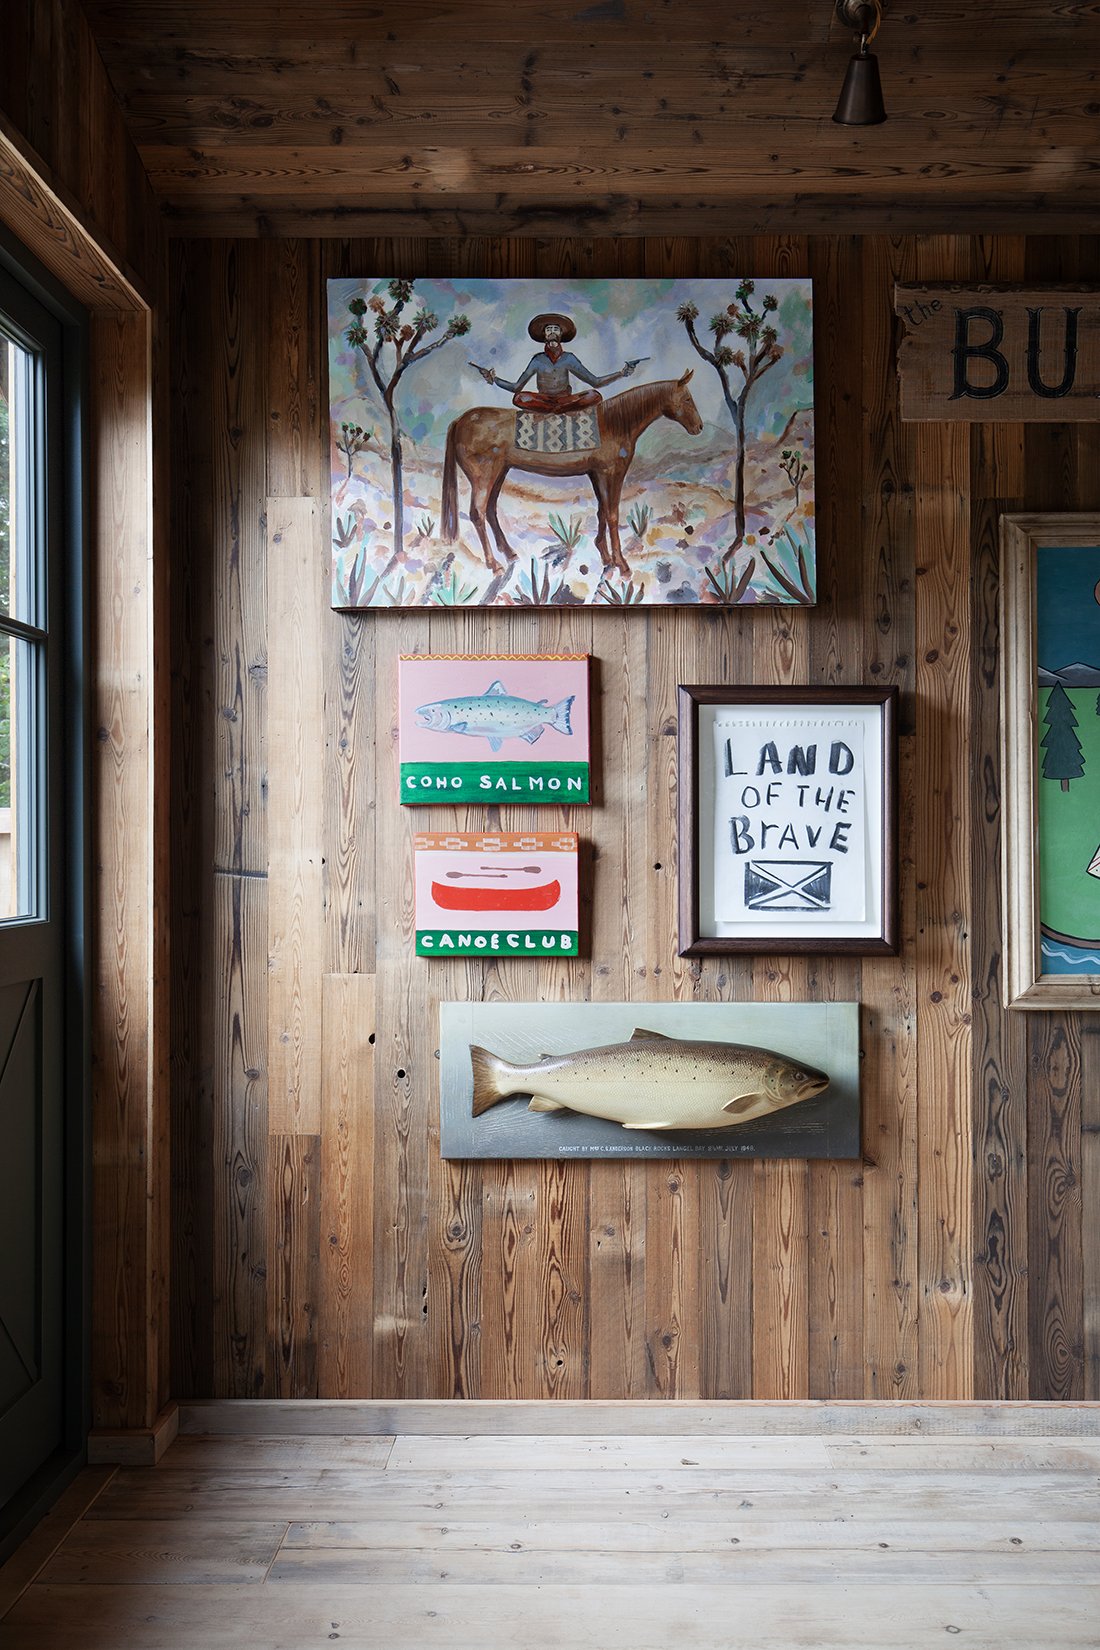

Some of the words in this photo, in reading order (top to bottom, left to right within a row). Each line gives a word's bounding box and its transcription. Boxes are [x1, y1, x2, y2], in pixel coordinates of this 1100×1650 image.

[903, 299, 943, 326] the
[948, 306, 1100, 400] BU
[724, 738, 855, 778] LAND
[406, 775, 463, 790] COHO
[479, 774, 582, 791] SALMON
[741, 782, 783, 809] OF
[797, 785, 856, 813] THE
[421, 934, 500, 950] CANOE
[506, 934, 573, 950] CLUB
